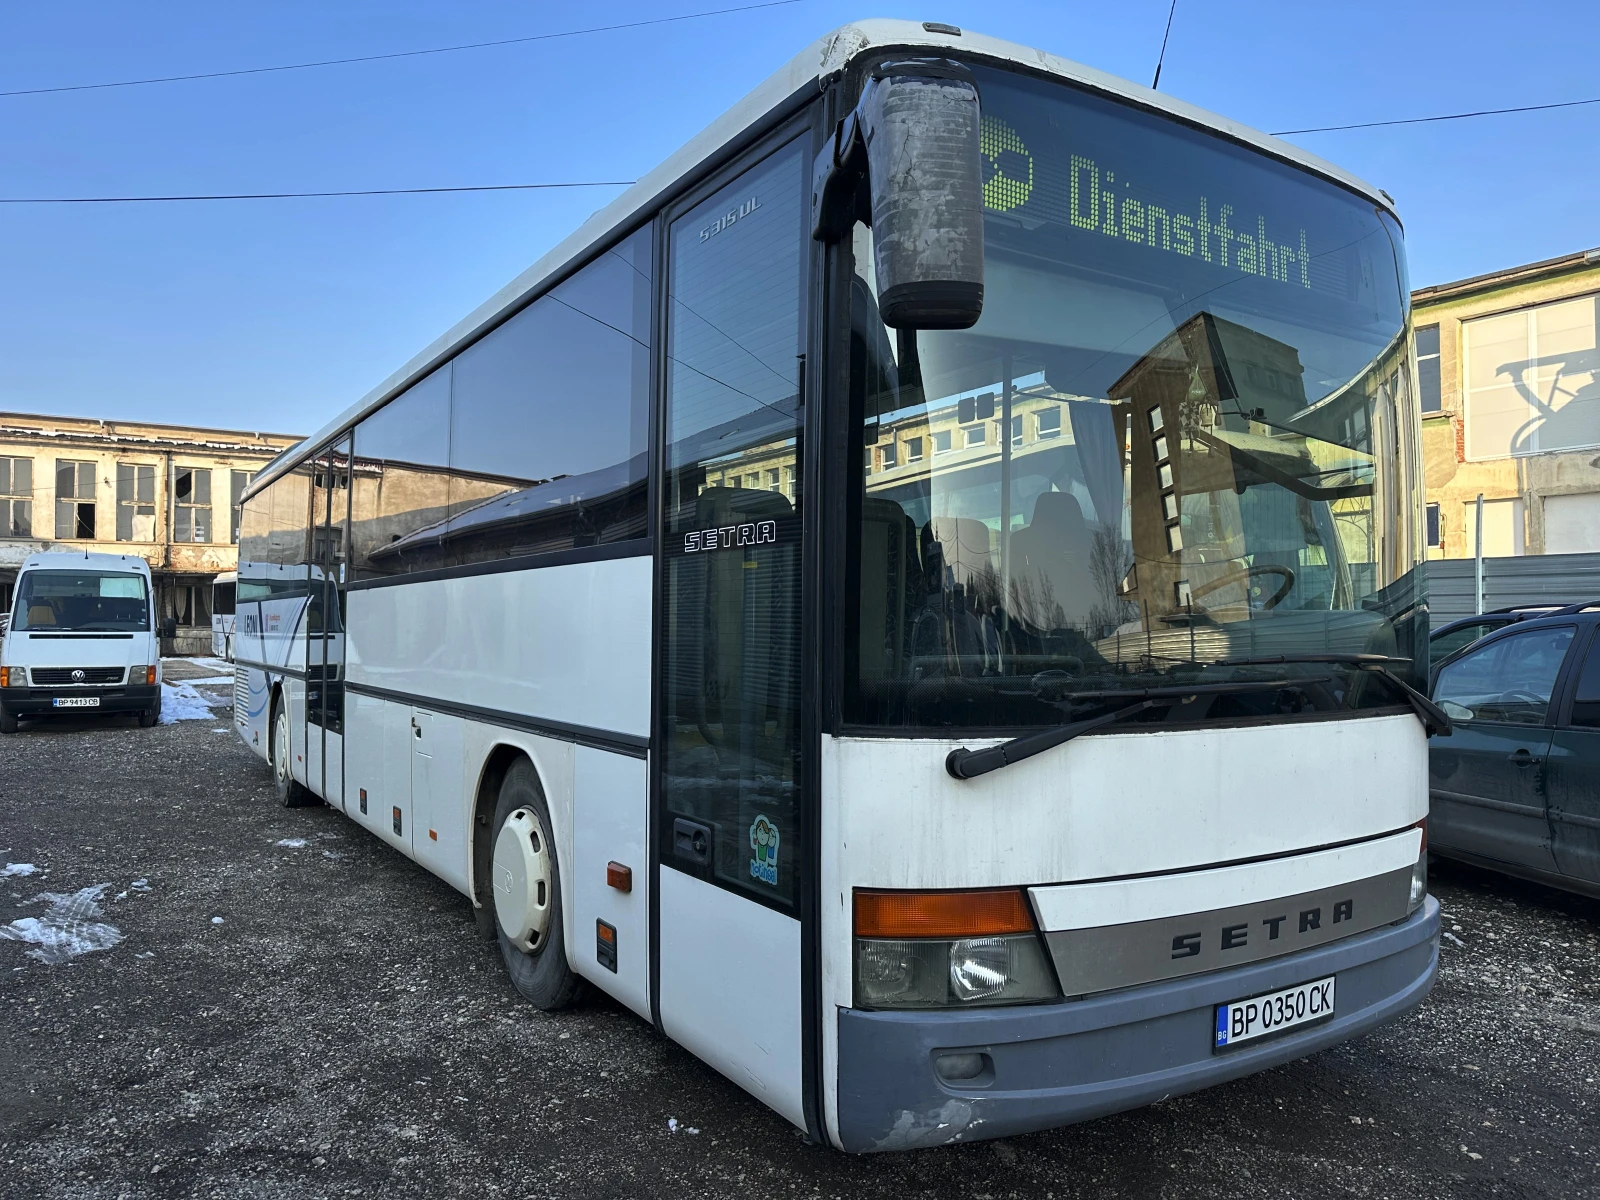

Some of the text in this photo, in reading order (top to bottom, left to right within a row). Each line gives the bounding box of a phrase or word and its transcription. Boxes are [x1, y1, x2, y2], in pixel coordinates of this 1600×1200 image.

[740, 196, 762, 219] UL
[1071, 154, 1310, 288] Dienstfahrt
[685, 520, 775, 552] SETRA
[1171, 898, 1353, 959] SETRA
[1231, 982, 1331, 1038] BP 0350 CK
[1217, 1030, 1227, 1041] BG
